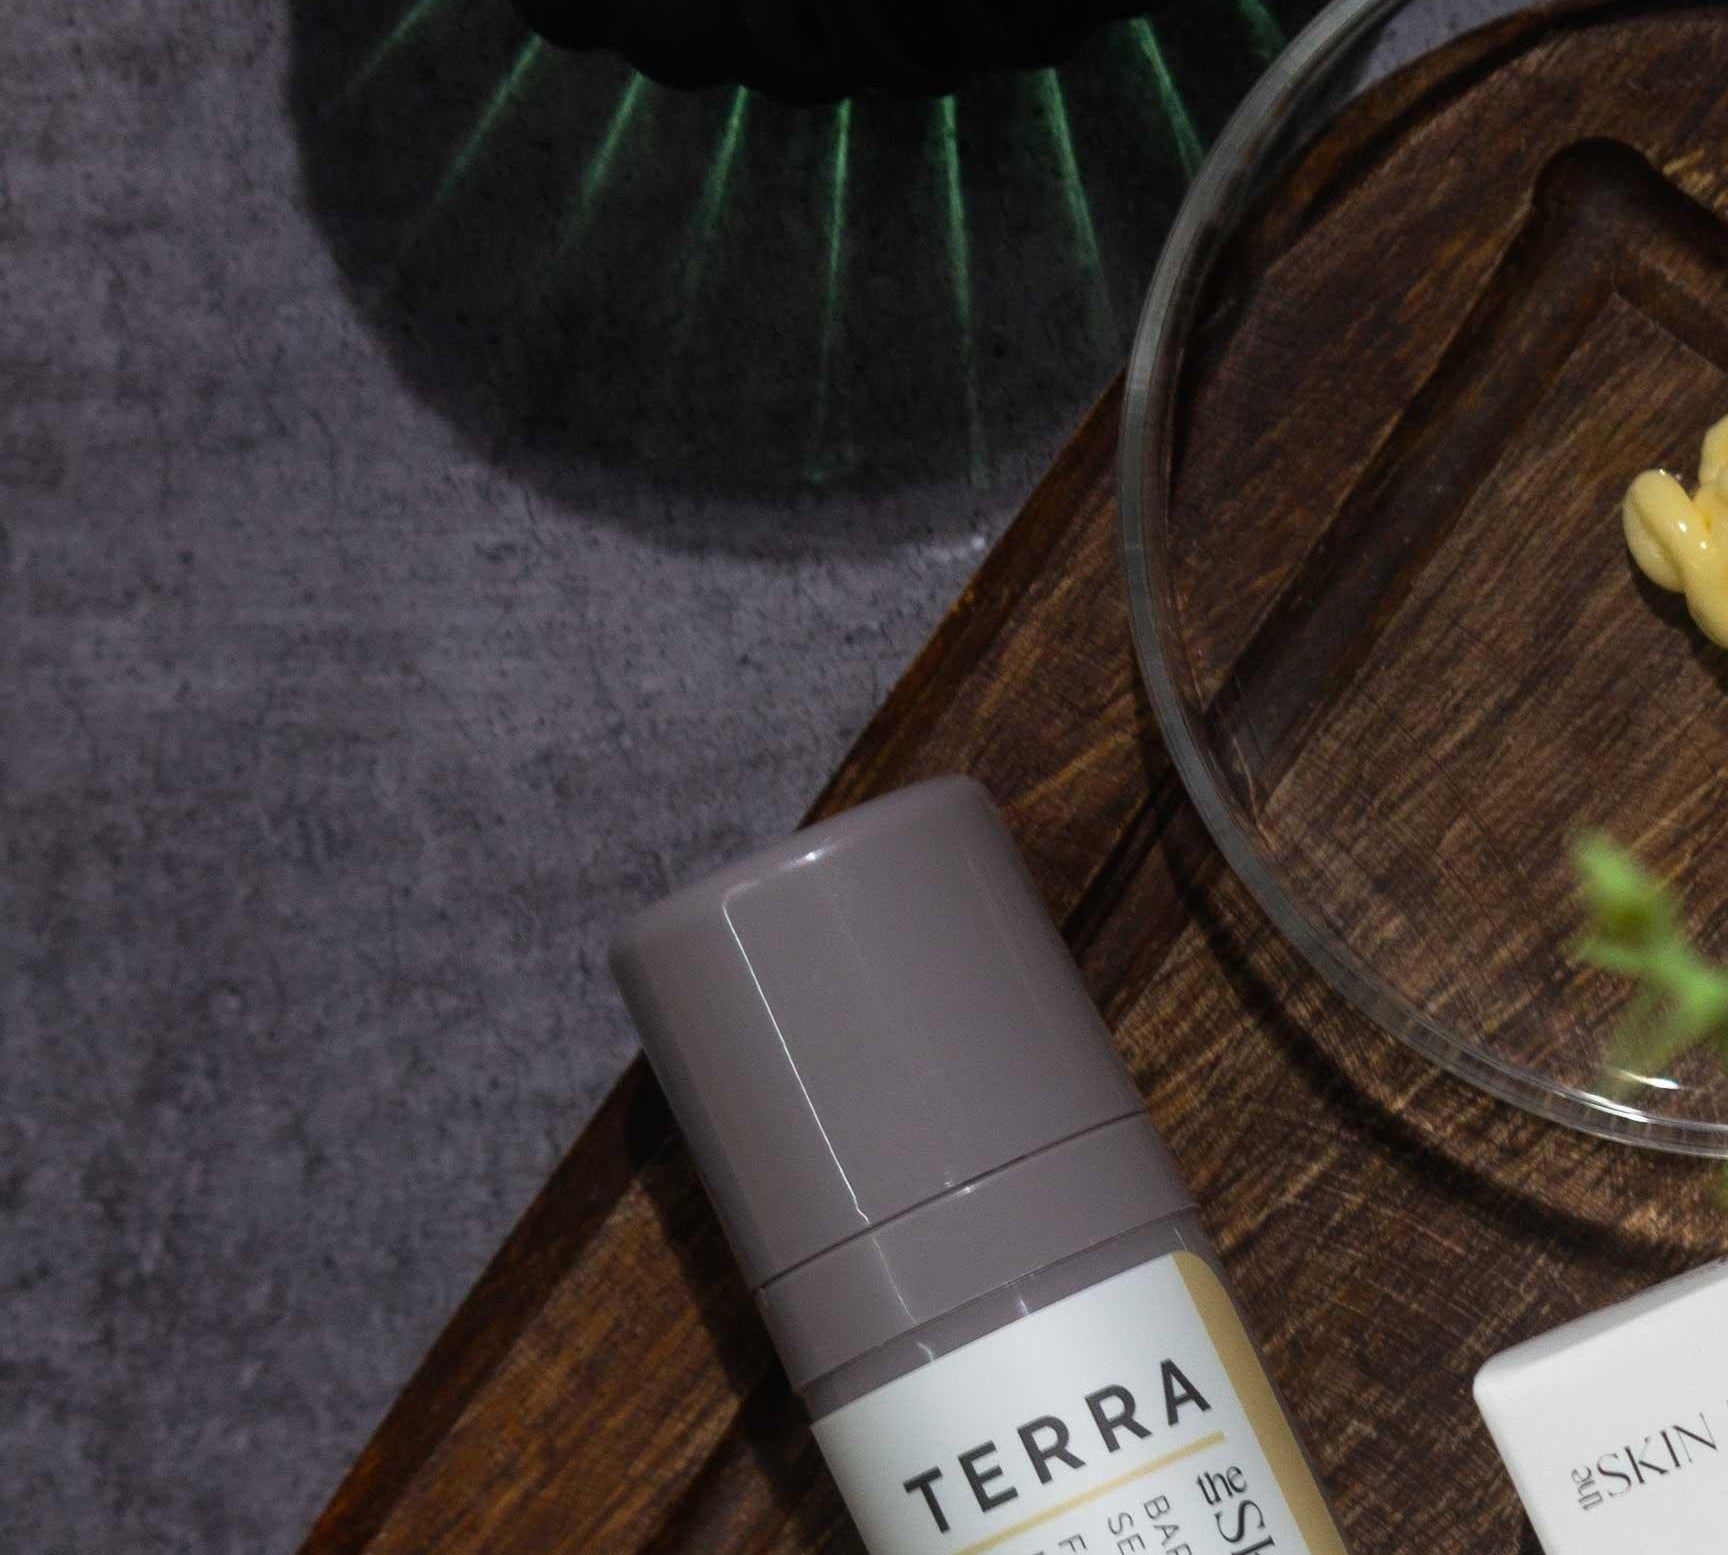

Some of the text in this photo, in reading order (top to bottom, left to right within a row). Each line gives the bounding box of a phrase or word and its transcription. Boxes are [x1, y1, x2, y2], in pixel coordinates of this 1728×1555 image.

[902, 1358, 1211, 1535] TERRA
[1197, 1467, 1246, 1505] the
[1571, 1467, 1603, 1511] the
[1596, 1412, 1718, 1499] SKIN
